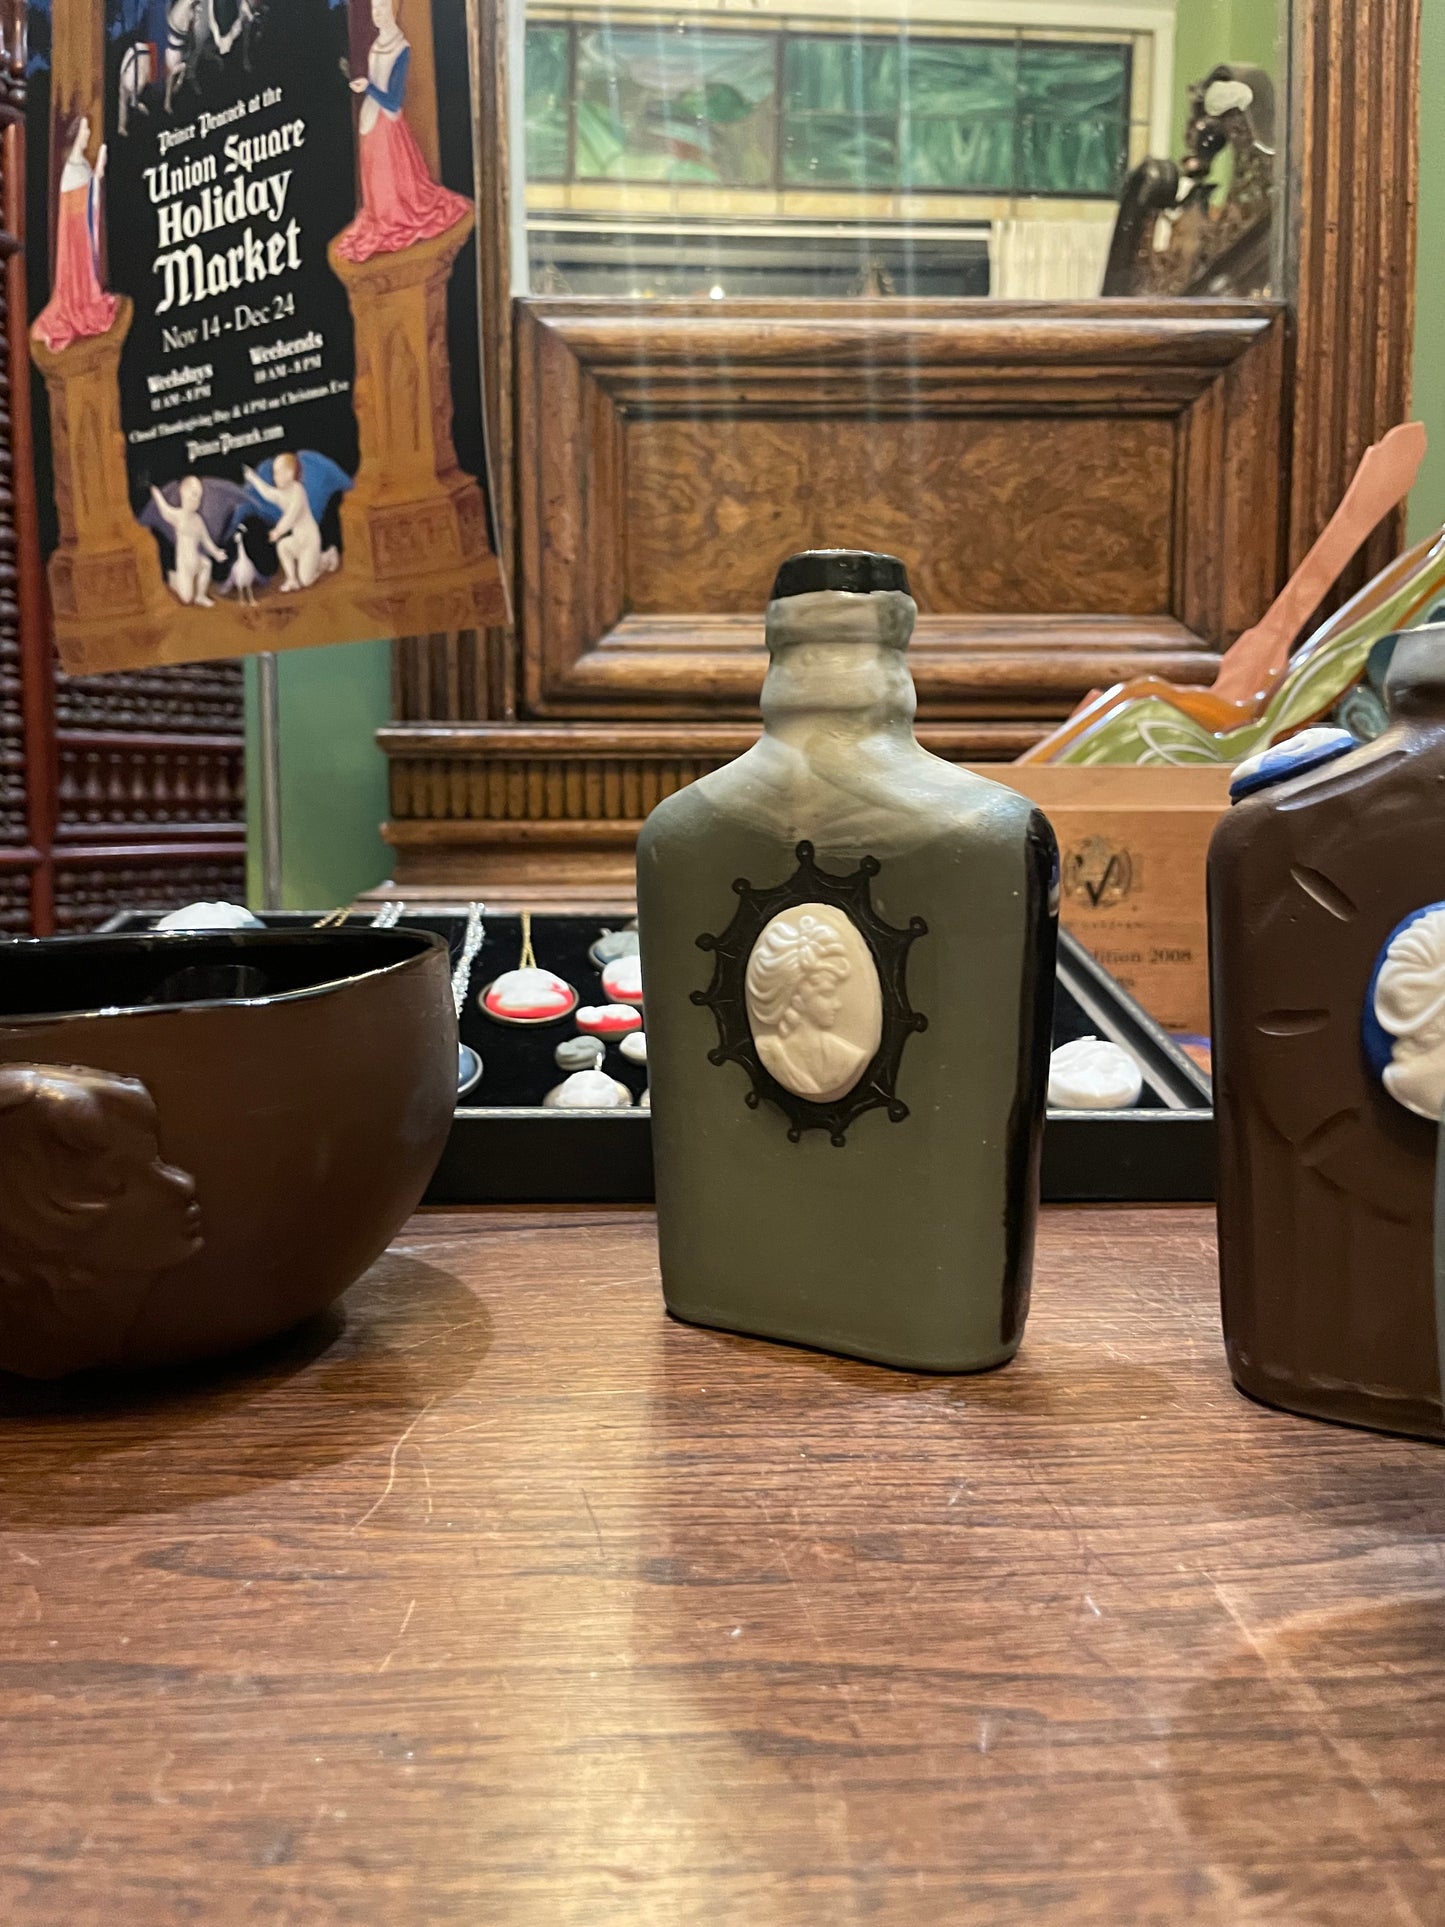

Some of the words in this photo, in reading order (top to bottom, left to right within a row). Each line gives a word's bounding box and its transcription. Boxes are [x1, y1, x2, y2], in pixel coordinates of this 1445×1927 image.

[197, 100, 246, 138] Peacock
[248, 94, 261, 114] at
[262, 86, 282, 108] the
[142, 153, 217, 204] Union
[223, 118, 305, 175] Square
[157, 168, 293, 248] Holiday
[153, 216, 302, 316] Market
[162, 325, 199, 353] Nov
[202, 314, 221, 341] 14
[234, 304, 271, 332] Dec
[271, 291, 295, 320] 24
[249, 330, 324, 366] Weekends
[147, 363, 214, 394] Weekdays
